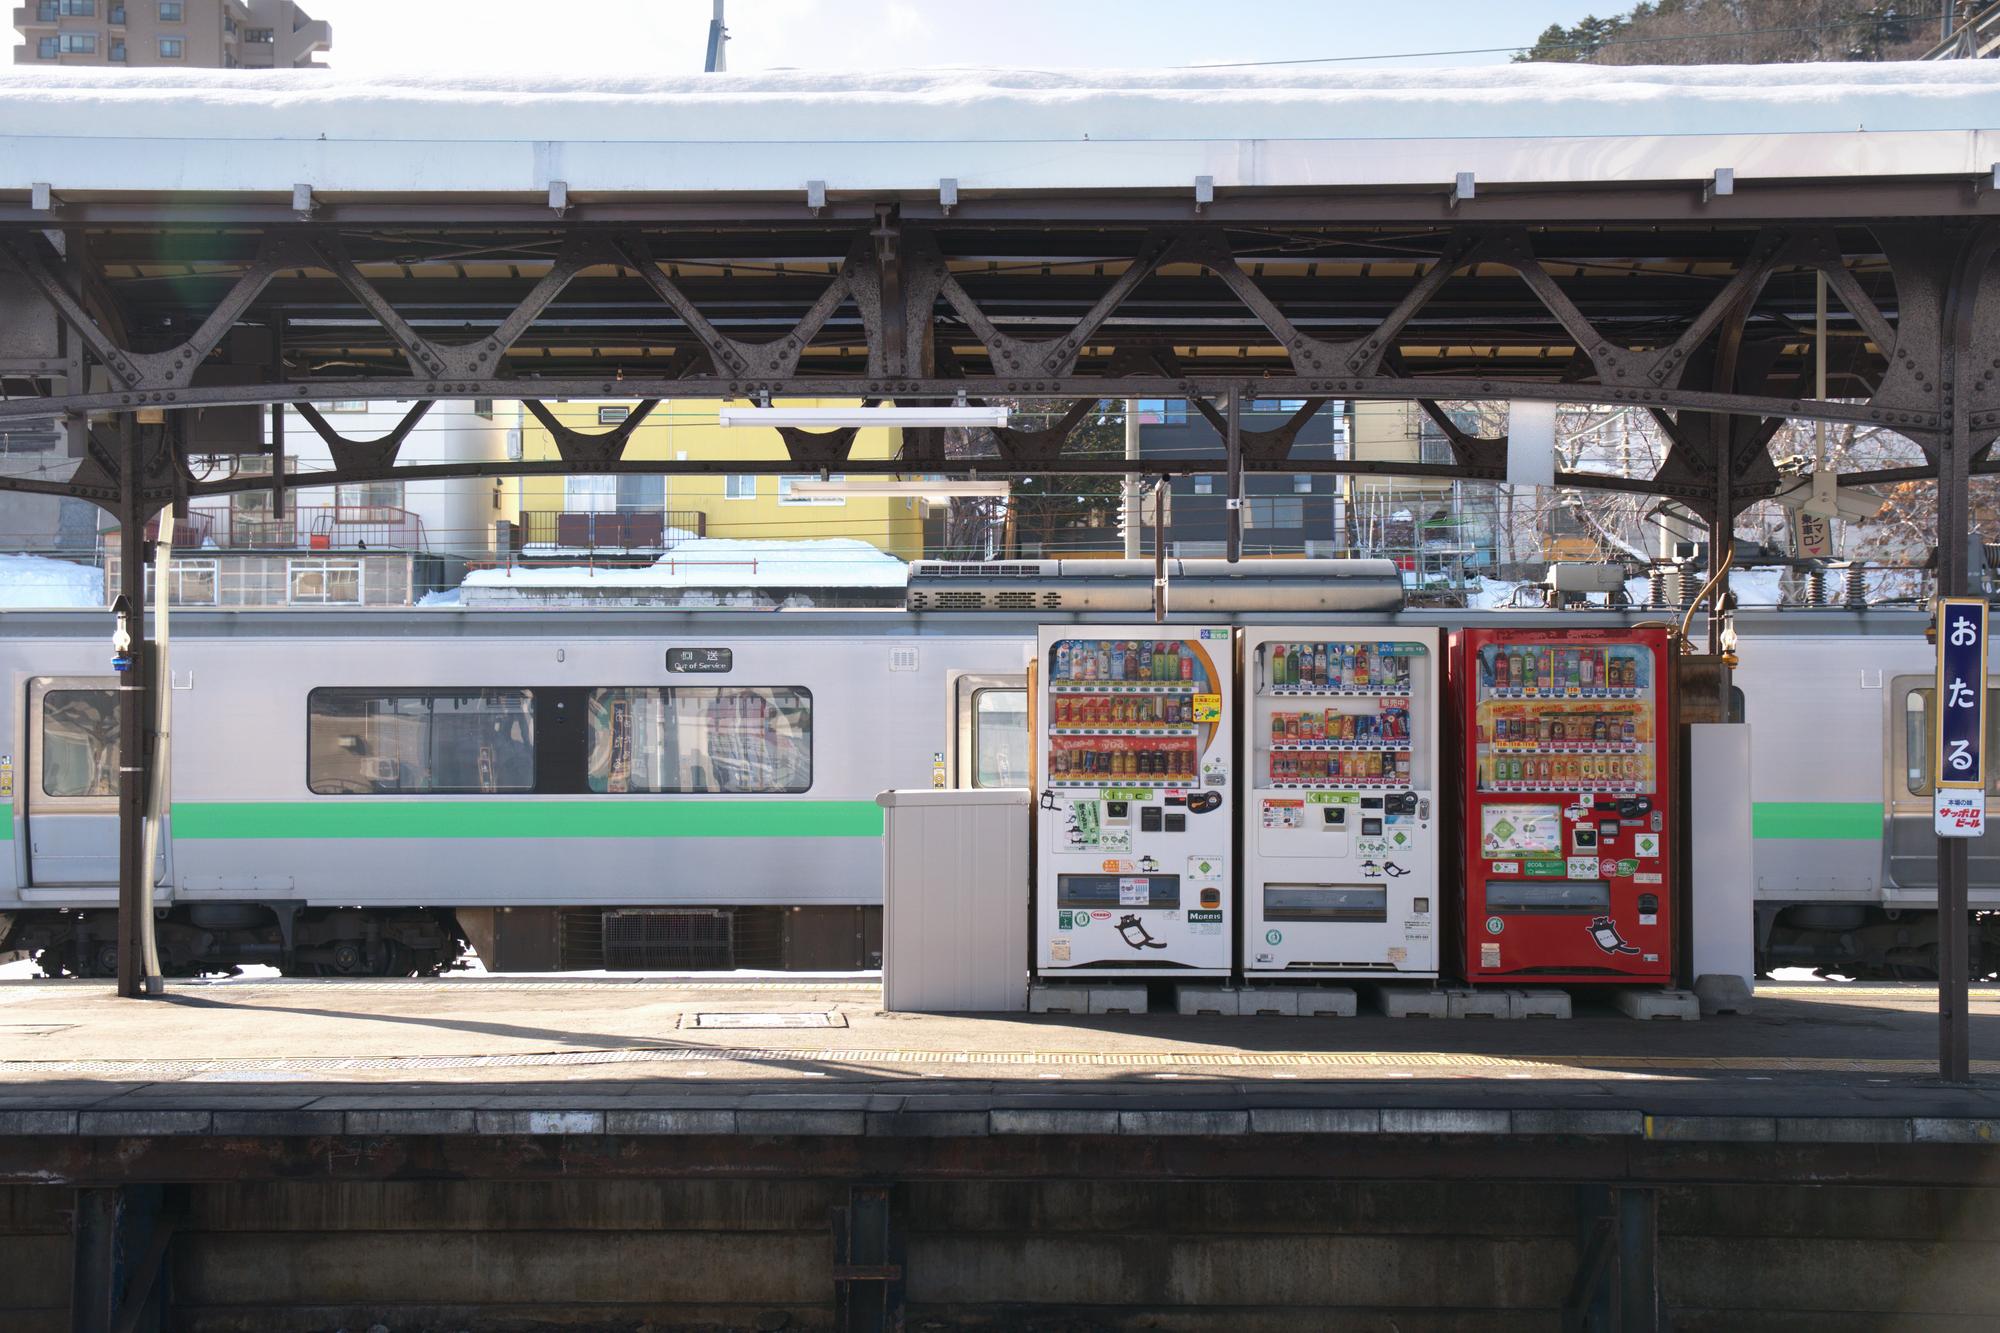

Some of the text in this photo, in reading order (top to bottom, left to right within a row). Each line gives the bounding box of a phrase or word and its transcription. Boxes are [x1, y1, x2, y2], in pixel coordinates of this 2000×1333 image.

[682, 650, 720, 661] 回送
[1947, 615, 1978, 771] おたる
[1102, 789, 1153, 800] Kitaca
[1307, 793, 1359, 803] Kitaca
[1939, 808, 1981, 818] サッポロ
[1955, 819, 1981, 828] ビール
[1190, 912, 1221, 920] MORRIS
